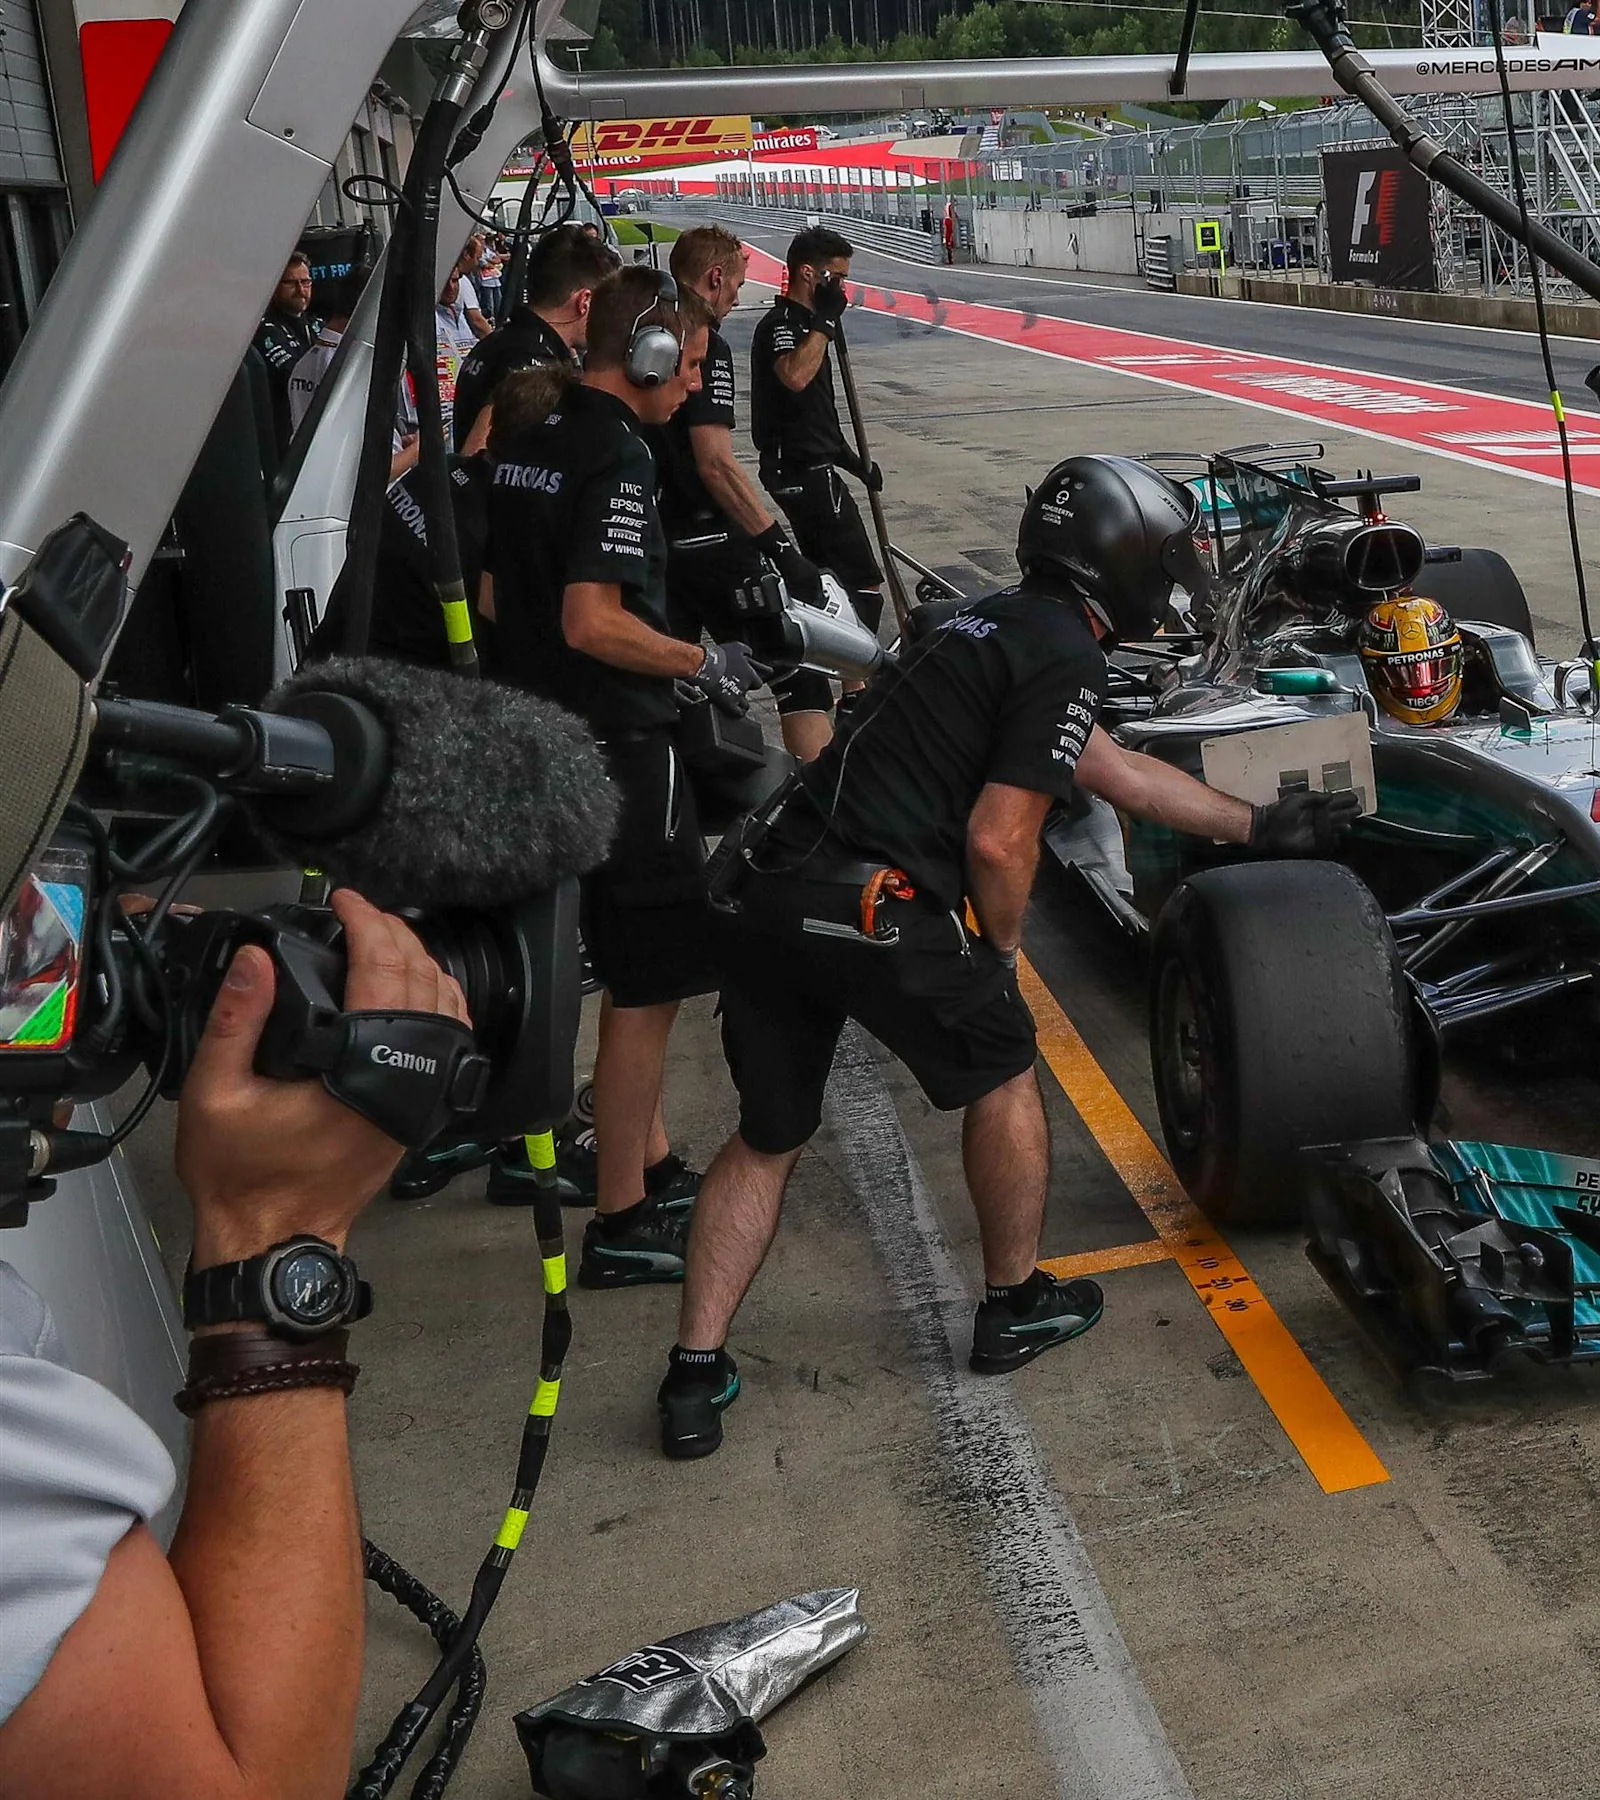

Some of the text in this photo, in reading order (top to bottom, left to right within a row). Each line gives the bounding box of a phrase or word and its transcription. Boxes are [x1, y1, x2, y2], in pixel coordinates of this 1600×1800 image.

[596, 119, 723, 148] DHL
[748, 132, 812, 155] mirates
[1348, 249, 1374, 262] Formula
[619, 482, 643, 497] IWC
[609, 497, 645, 515] EPSON
[1387, 647, 1445, 666] PETRONAS
[1078, 687, 1099, 706] IWC
[370, 1044, 437, 1075] Canon
[679, 1352, 716, 1363] PUMA
